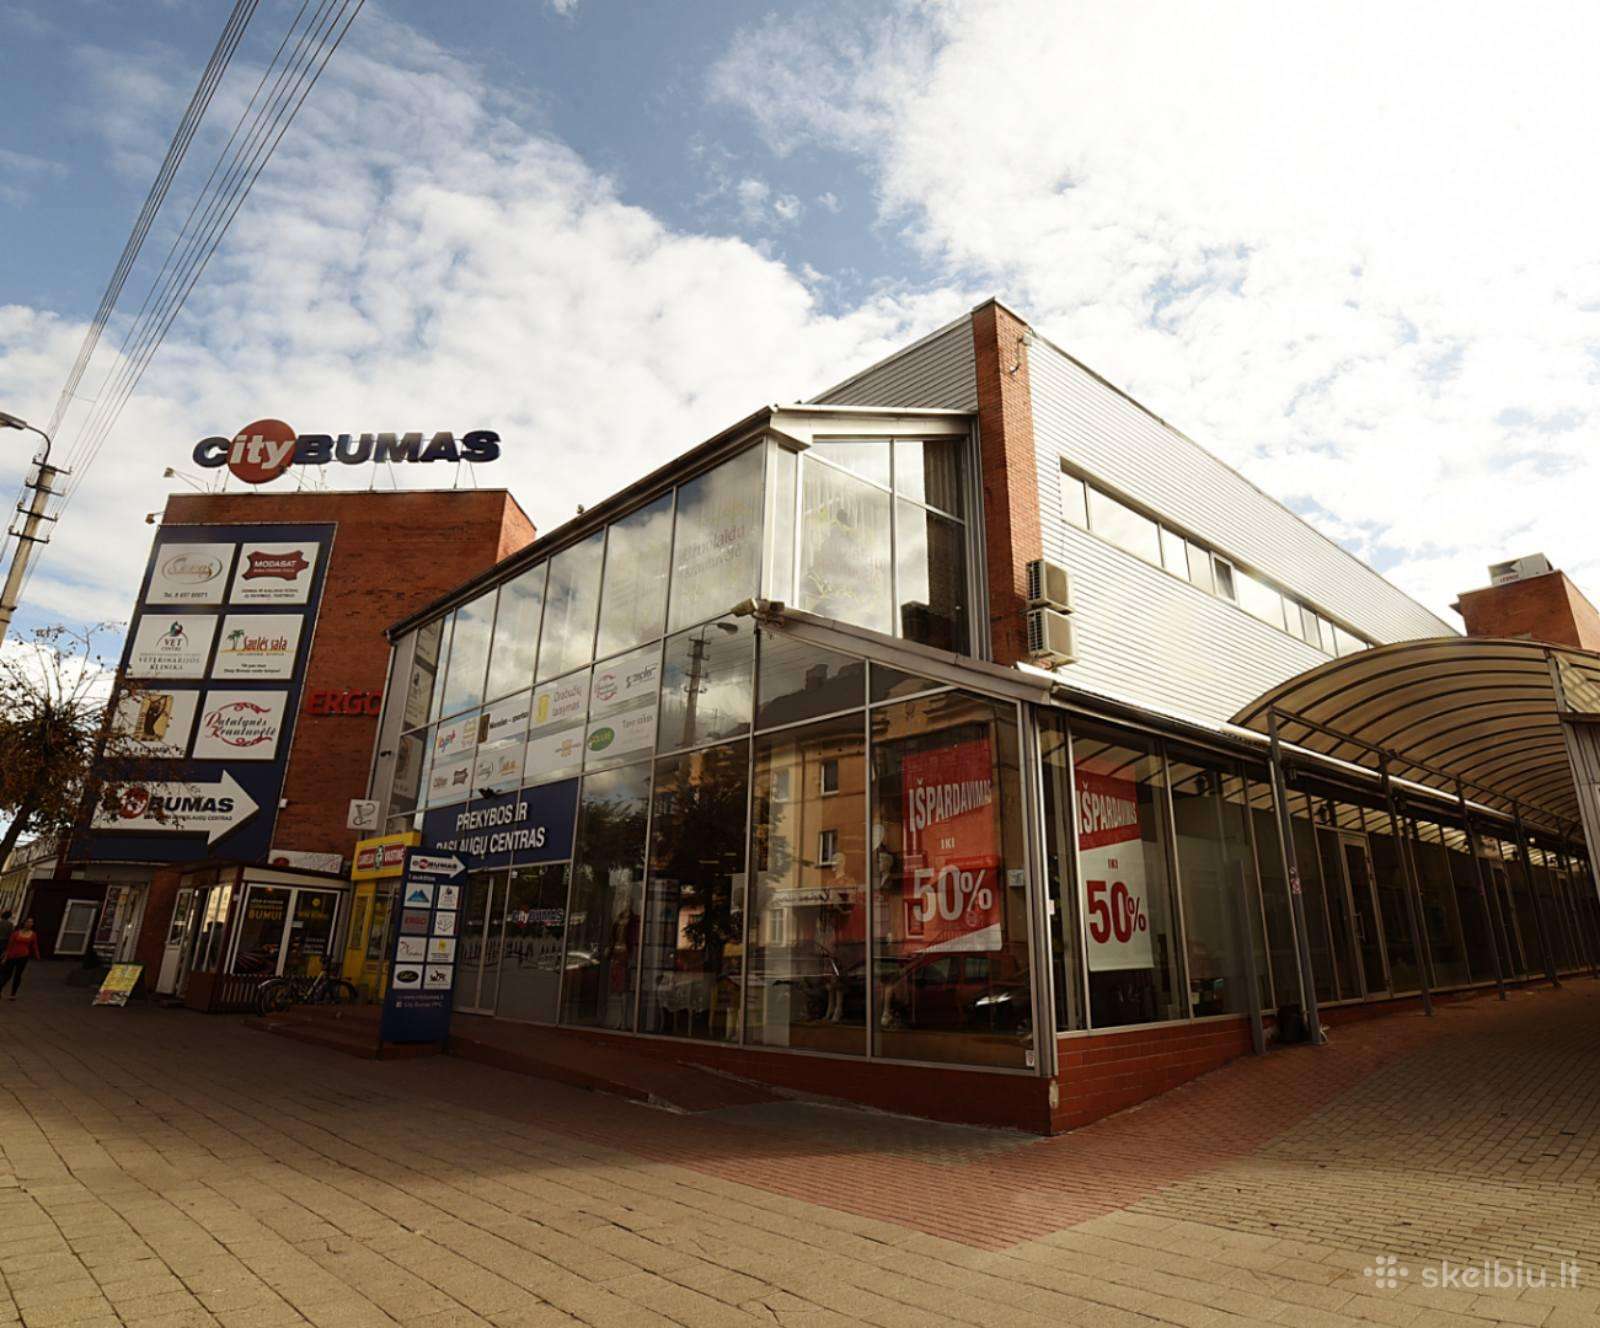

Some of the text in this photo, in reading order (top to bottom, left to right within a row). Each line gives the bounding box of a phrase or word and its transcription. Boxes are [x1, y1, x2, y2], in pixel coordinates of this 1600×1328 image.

[254, 560, 298, 568] MODASAT
[164, 638, 183, 647] VET
[309, 691, 383, 715] ERGO
[455, 801, 528, 831] PREKYBOS IR
[489, 827, 546, 853] CENTRAS
[941, 837, 956, 849] IKI
[912, 865, 993, 922] 50%
[1086, 880, 1147, 944] 50%
